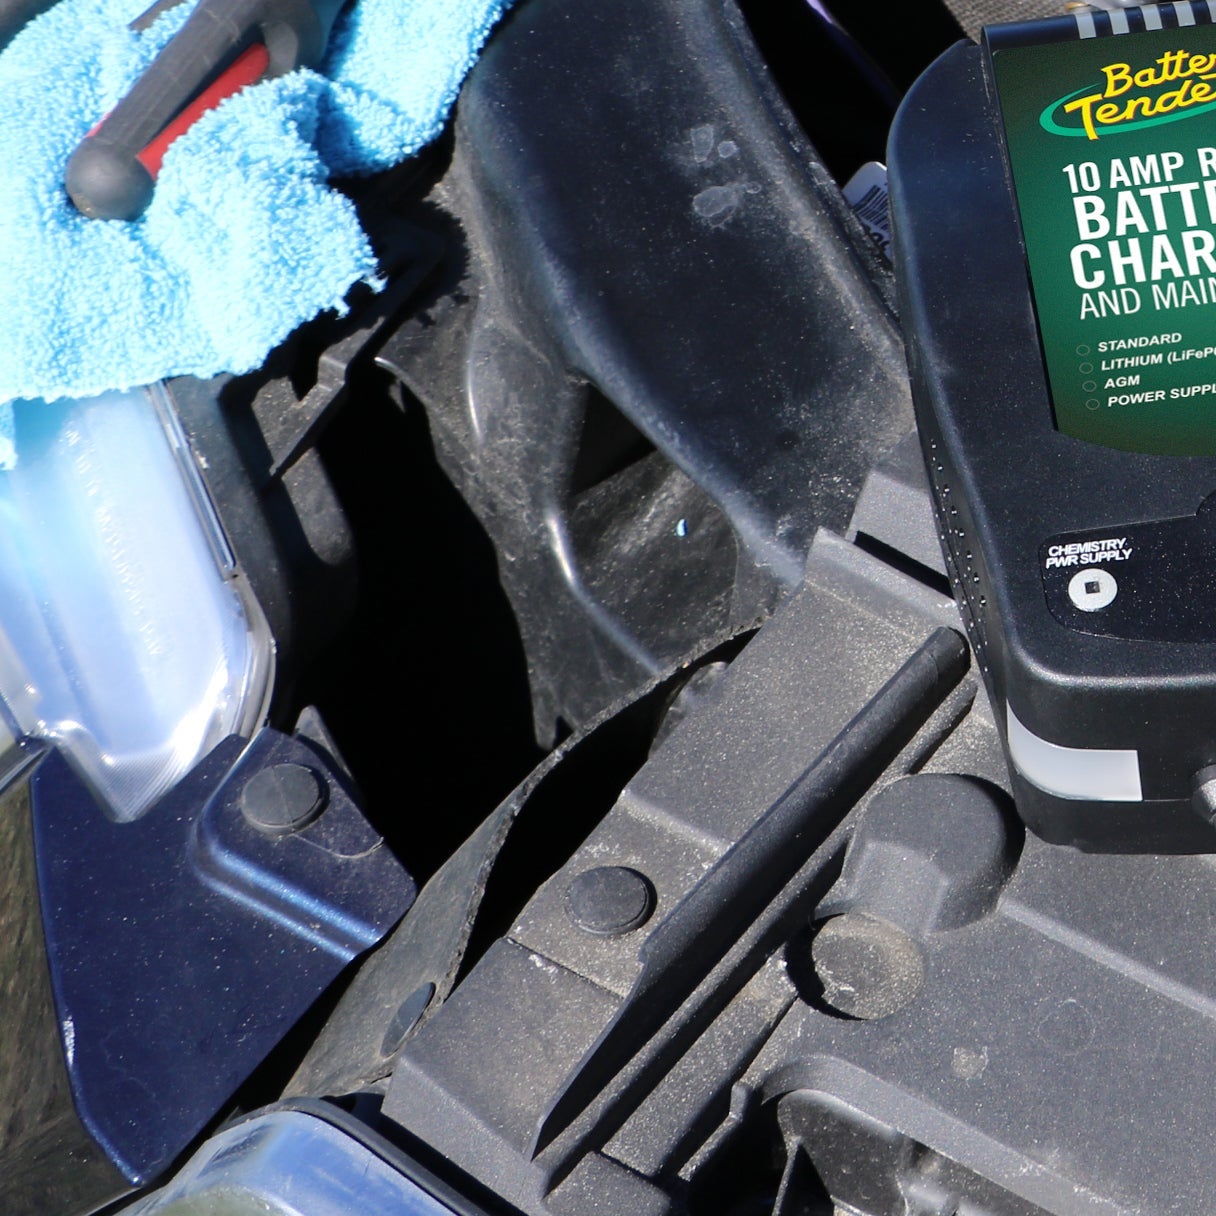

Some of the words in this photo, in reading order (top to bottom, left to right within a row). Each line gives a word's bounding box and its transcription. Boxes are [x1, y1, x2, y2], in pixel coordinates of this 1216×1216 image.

[1062, 162, 1101, 193] 10
[1109, 151, 1185, 189] AMP
[1079, 287, 1142, 320] AND
[1098, 333, 1183, 352] STANDARD
[1101, 353, 1163, 371] LITHIUM
[1104, 374, 1141, 390] AGM
[1107, 389, 1166, 408] POWER
[1048, 537, 1128, 558] CHEMISTRY
[1045, 555, 1079, 570] PWR
[1079, 548, 1133, 565] SUPPLY
